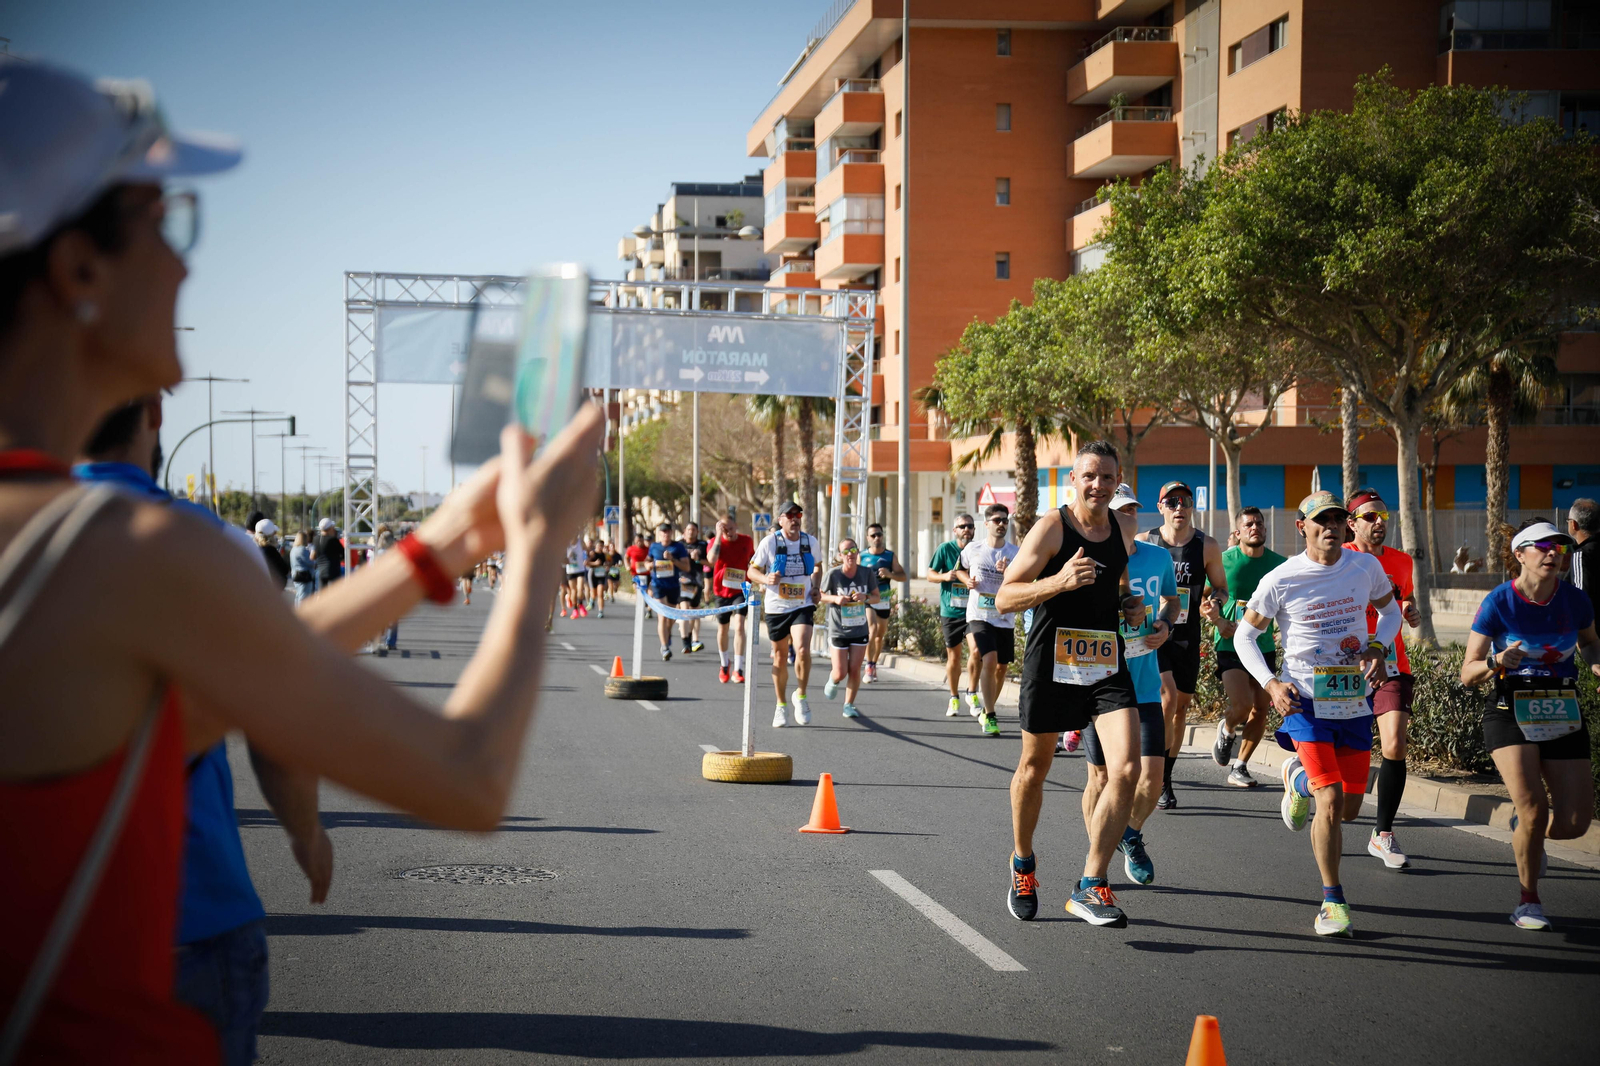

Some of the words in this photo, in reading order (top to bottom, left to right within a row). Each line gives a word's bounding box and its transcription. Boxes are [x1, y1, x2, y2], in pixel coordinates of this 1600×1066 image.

[1307, 602, 1325, 611] Cada
[1327, 596, 1354, 608] zancada
[1317, 609, 1343, 619] victoria
[1344, 604, 1362, 613] sobre
[1321, 616, 1355, 628] esclerosis
[1063, 638, 1112, 657] 1016
[1326, 674, 1361, 691] 418
[1528, 699, 1567, 715] 652
